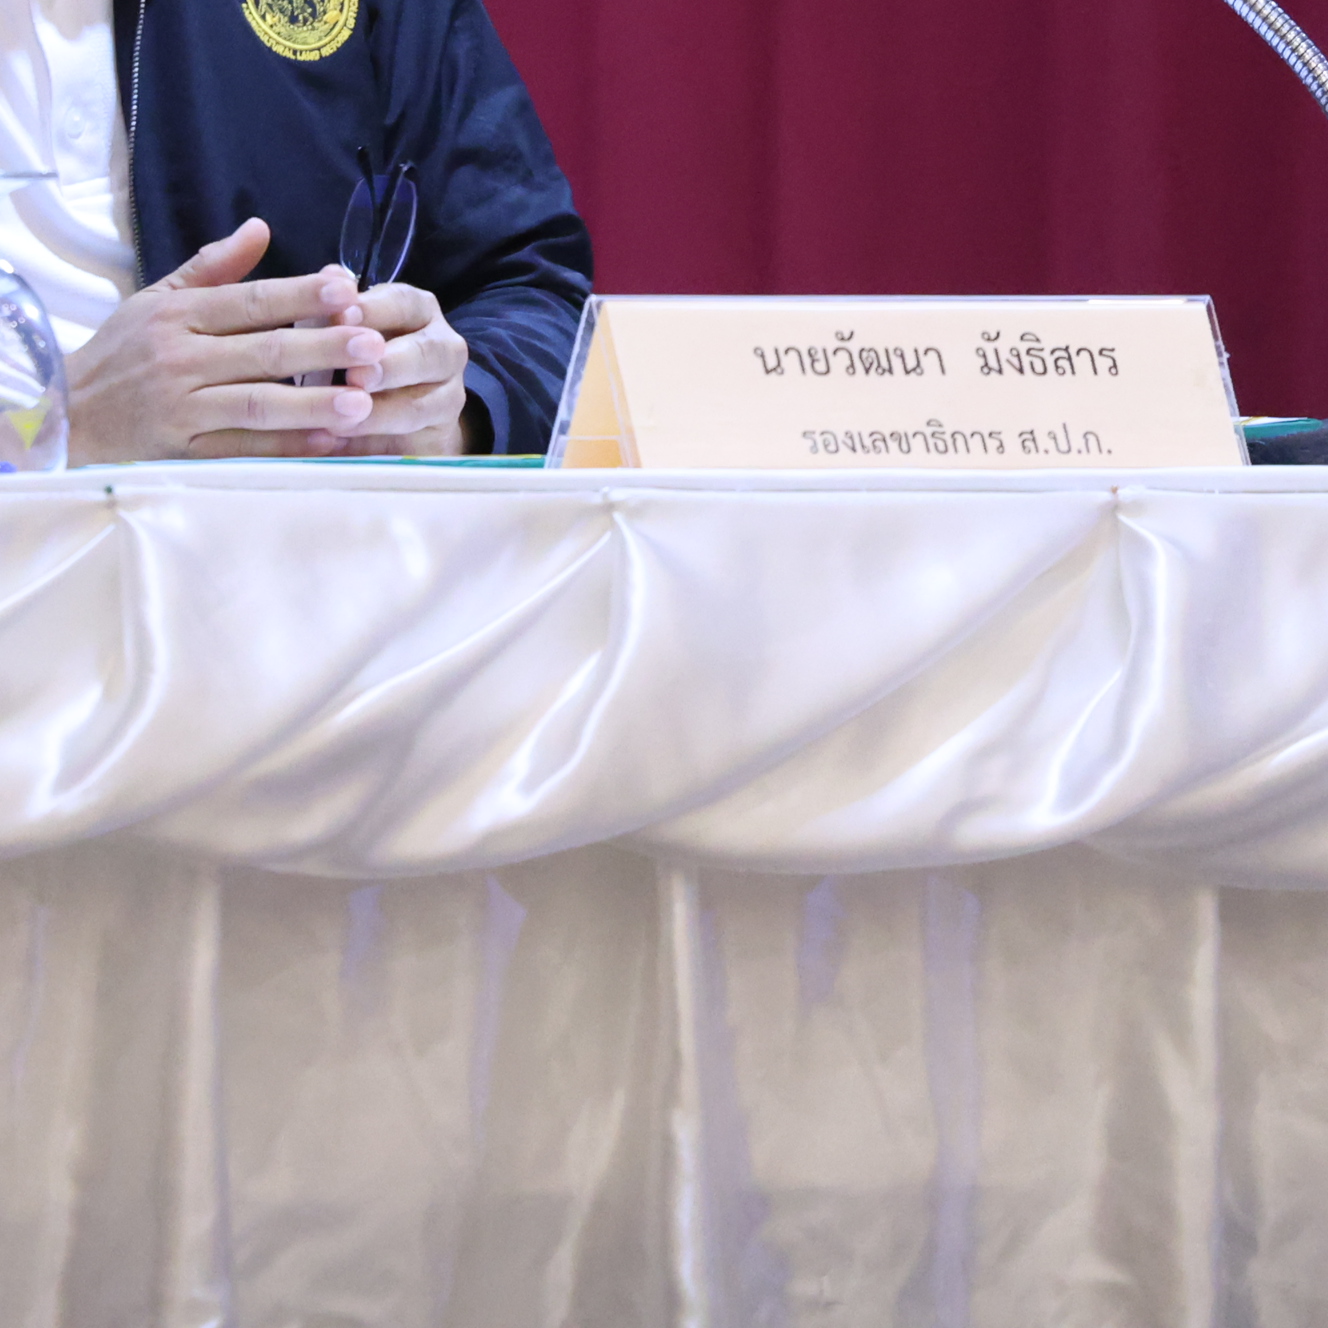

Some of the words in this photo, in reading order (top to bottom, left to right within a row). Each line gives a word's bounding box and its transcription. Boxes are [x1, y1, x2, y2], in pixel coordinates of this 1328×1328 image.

[753, 330, 946, 376] นายวัฒนา
[975, 330, 1120, 376] มังธิสาร
[802, 418, 1006, 455] รองเลขาธิการ
[1018, 423, 1113, 455] ส.ป.ก.
